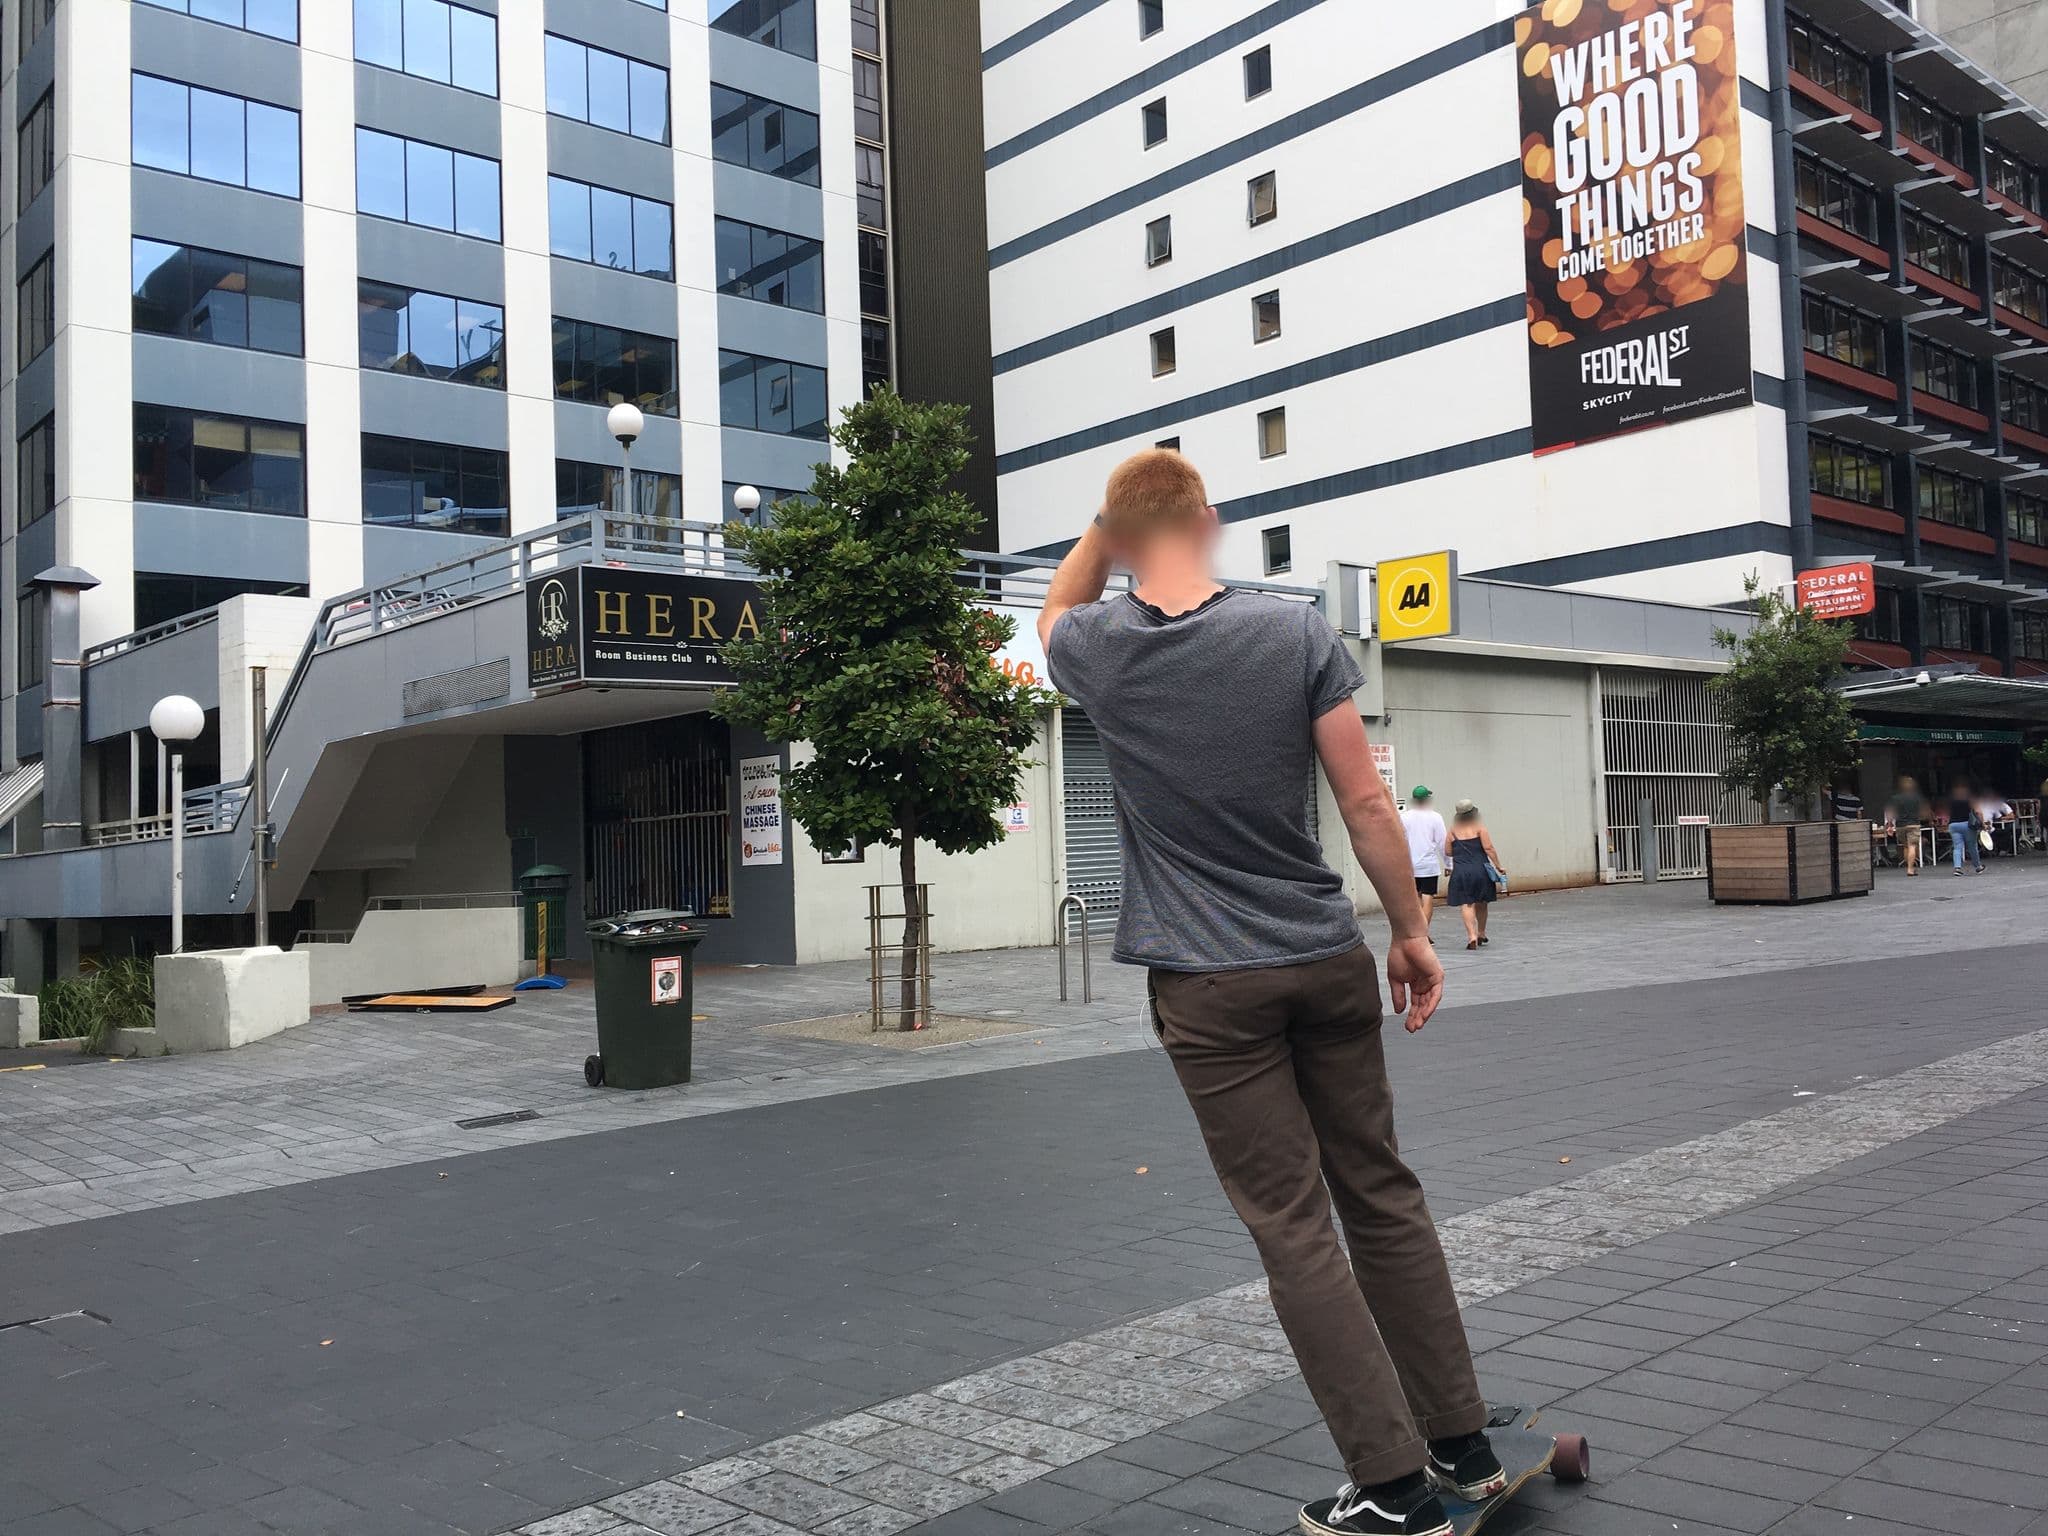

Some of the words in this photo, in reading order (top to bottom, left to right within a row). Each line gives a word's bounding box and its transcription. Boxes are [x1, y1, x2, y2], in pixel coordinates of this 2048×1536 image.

[1550, 0, 1696, 107] WHERE
[1553, 63, 1700, 194] GOOD
[1555, 152, 1703, 252] THINGS
[1557, 243, 1606, 282] COME
[1610, 212, 1705, 266] TOGETHER
[1580, 331, 1682, 387] FEDERAL
[1582, 390, 1633, 411] SKYCITY
[1801, 570, 1867, 589] FEDERAL
[1398, 582, 1430, 611] AA
[594, 590, 762, 641] HERA
[532, 643, 577, 672] HERA
[595, 649, 621, 660] Room
[625, 651, 668, 662] Business
[671, 653, 693, 663] Club
[705, 654, 718, 664] Ph
[743, 815, 780, 829] MASSAGE
[745, 803, 777, 816] CHINESE
